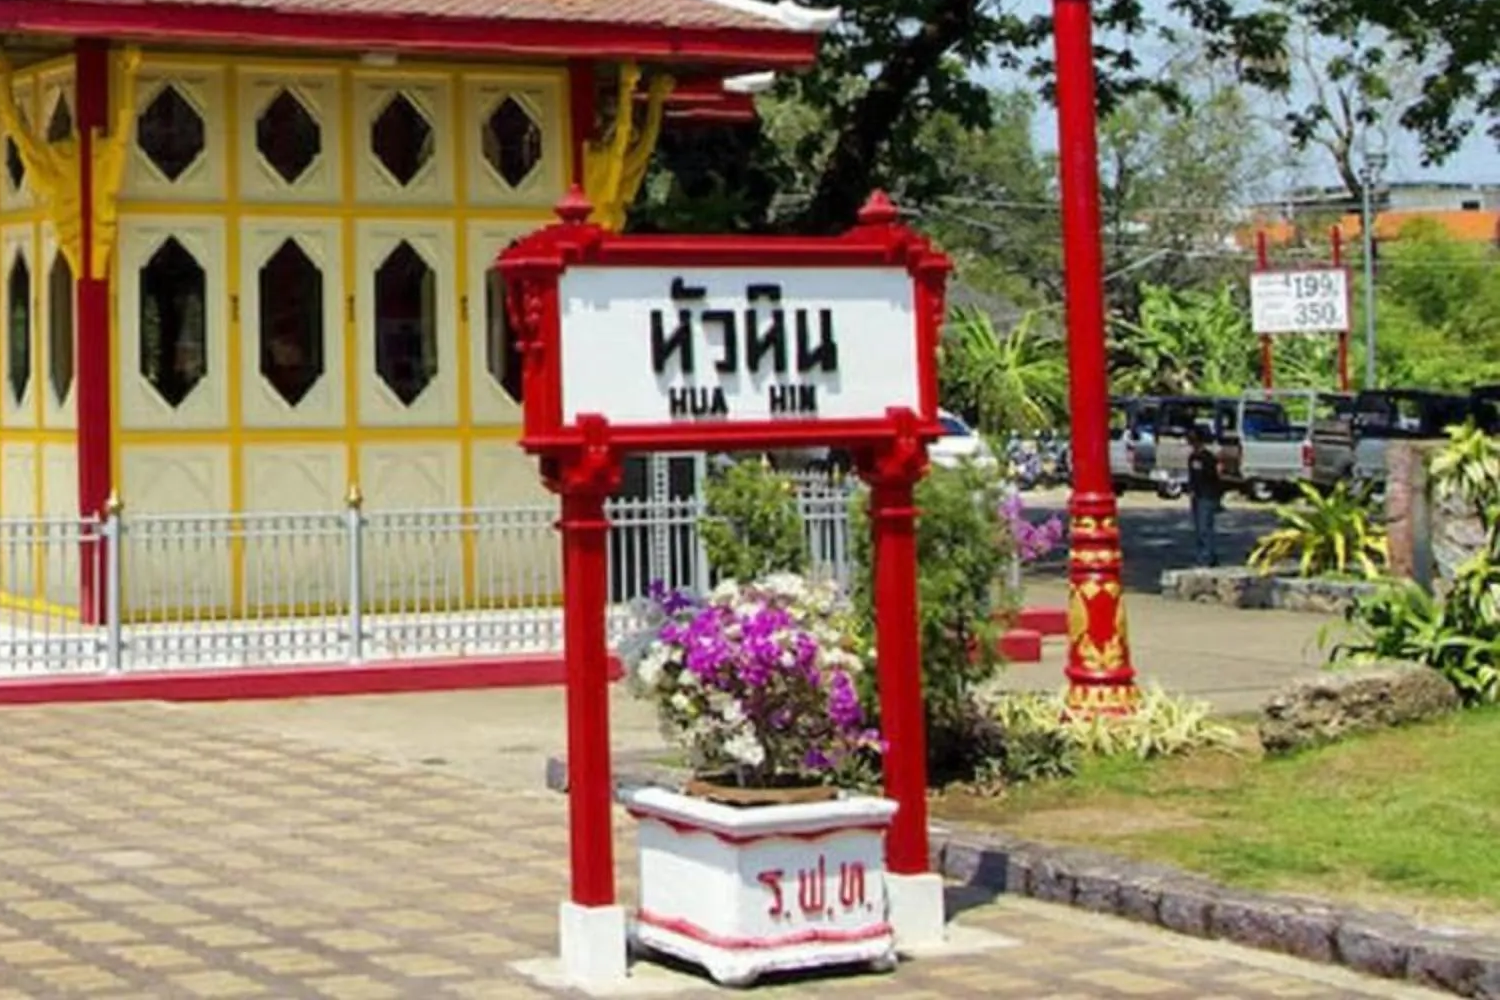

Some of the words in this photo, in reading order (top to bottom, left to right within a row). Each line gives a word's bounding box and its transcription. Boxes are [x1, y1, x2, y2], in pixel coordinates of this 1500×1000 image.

[650, 276, 838, 374] หัวหิน
[669, 386, 728, 416] HUA
[769, 384, 817, 413] HIN
